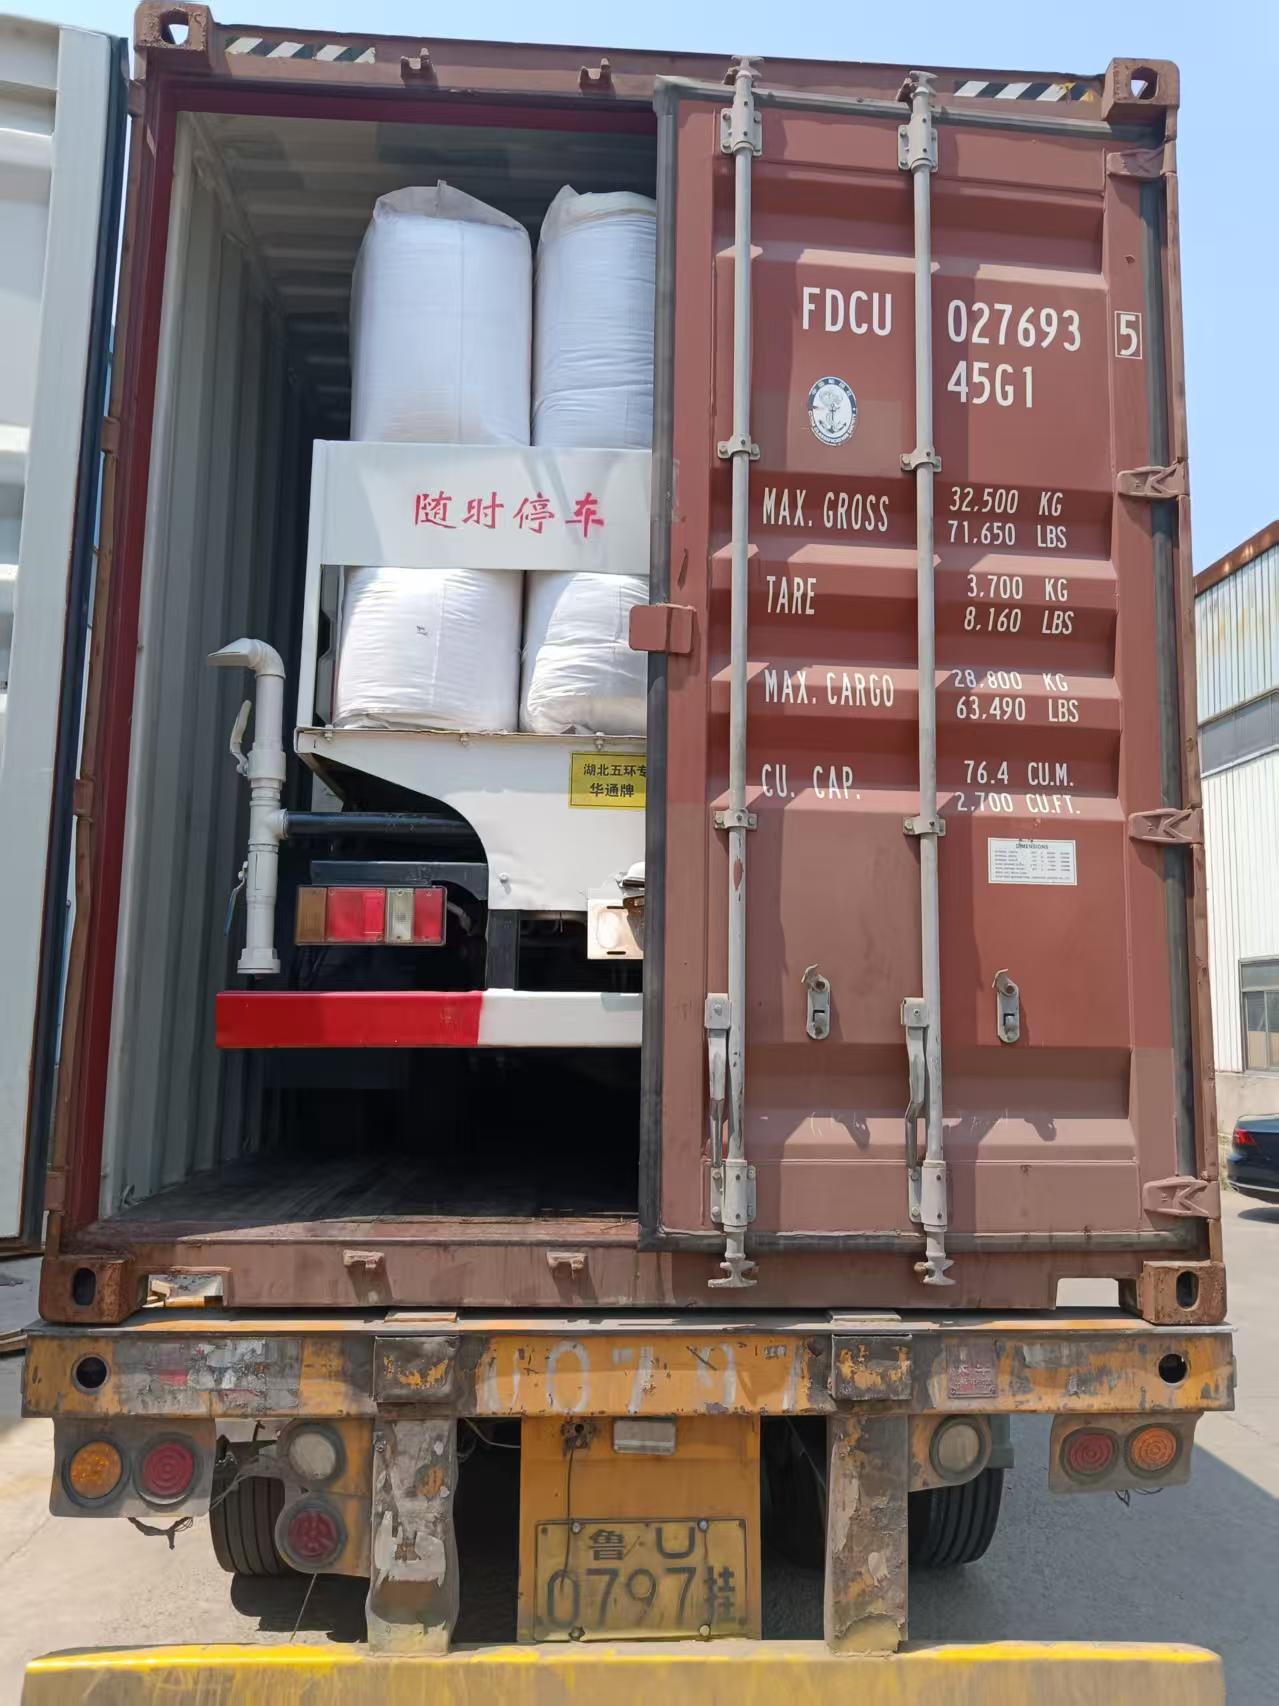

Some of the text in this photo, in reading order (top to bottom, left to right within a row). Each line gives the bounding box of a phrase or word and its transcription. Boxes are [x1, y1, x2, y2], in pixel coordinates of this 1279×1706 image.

[803, 287, 1139, 357] FDCU 027693 5
[948, 361, 1032, 408] 45G1
[414, 490, 605, 538] 随时停车
[763, 488, 889, 532] MAX. GROSS
[950, 488, 1063, 516] 32,500 KG
[948, 520, 1066, 548] 71,650 LBS
[767, 576, 816, 614] TARE
[968, 574, 1067, 601] 3,700 KG
[964, 607, 1074, 634] 8,160 LBS
[765, 670, 895, 707] MAX. CARGO
[1042, 673, 1069, 691] KG
[957, 696, 1078, 722] 63,490 LBS
[761, 765, 861, 801] CU. CAP.
[964, 760, 1073, 786] 76.4 CU.M.
[590, 782, 635, 798] 华通牌
